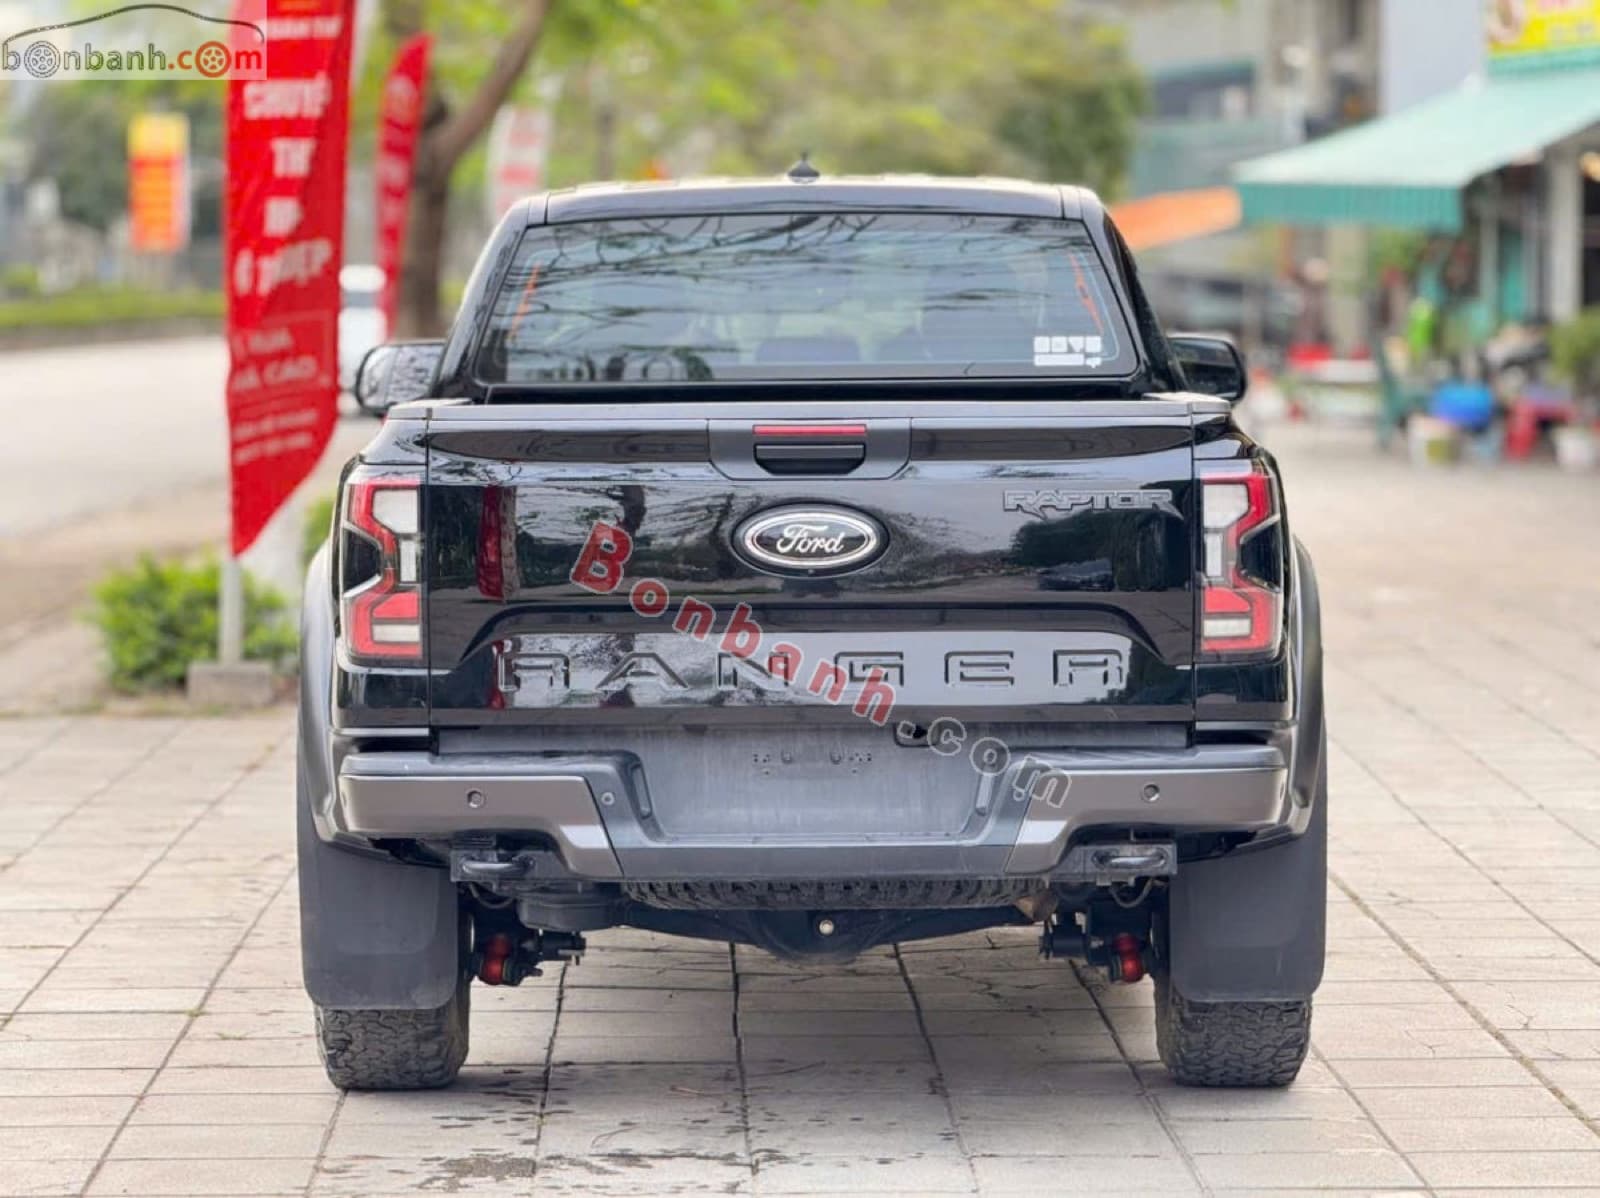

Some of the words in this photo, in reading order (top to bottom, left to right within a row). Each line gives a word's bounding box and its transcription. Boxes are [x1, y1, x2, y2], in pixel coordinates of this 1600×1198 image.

[1003, 489, 1184, 521] RAPTOR
[776, 523, 845, 554] Ford
[498, 648, 1126, 693] RANGER
